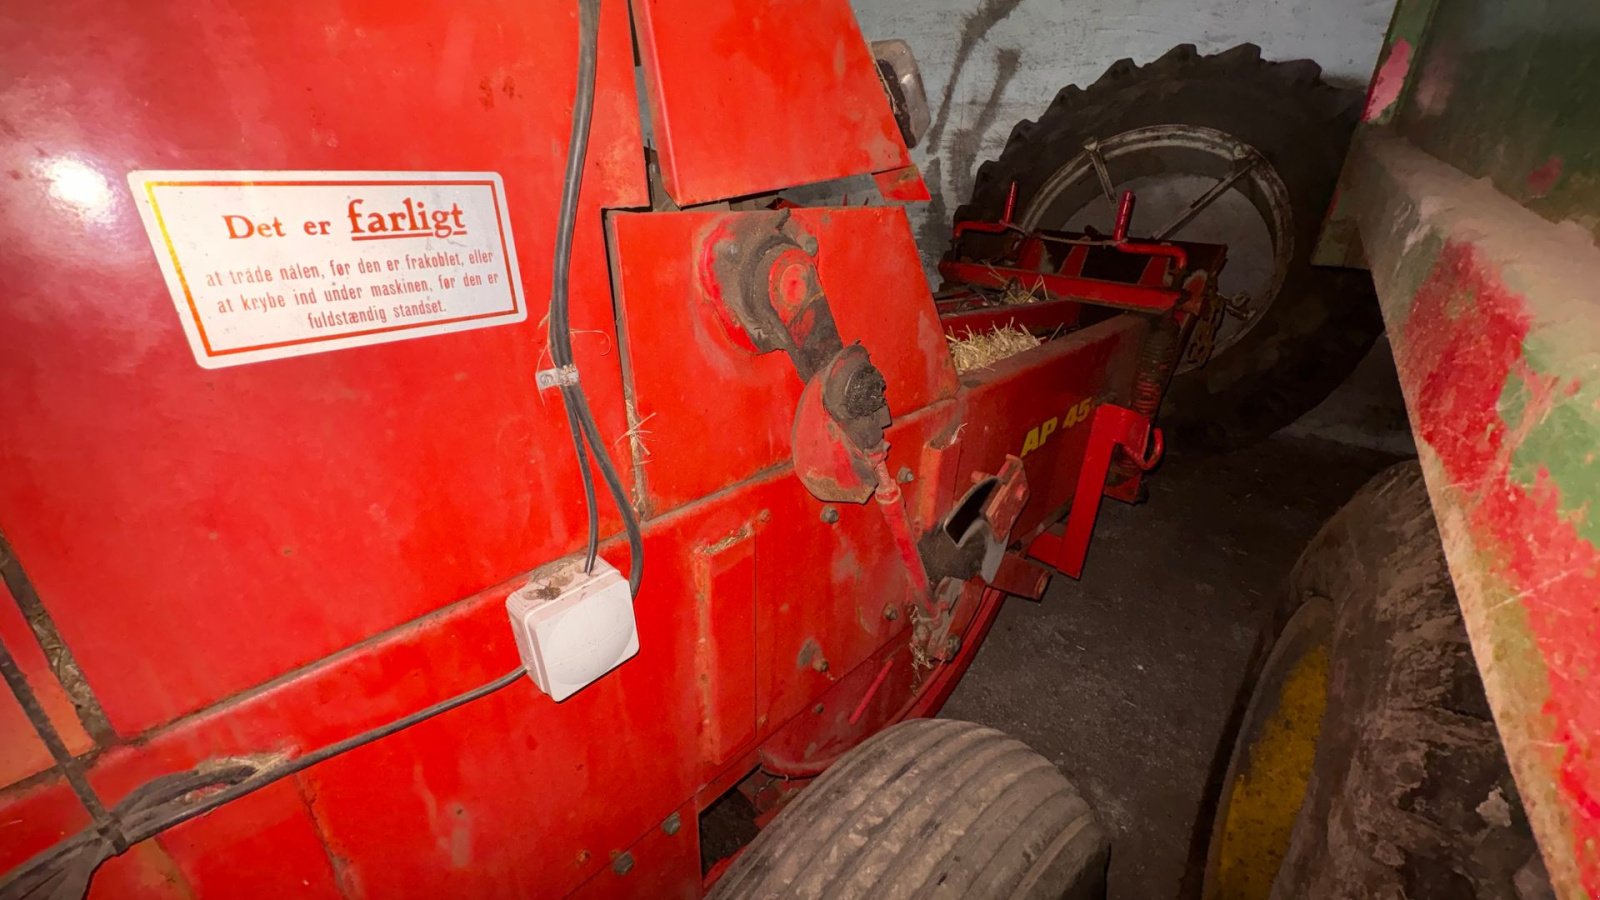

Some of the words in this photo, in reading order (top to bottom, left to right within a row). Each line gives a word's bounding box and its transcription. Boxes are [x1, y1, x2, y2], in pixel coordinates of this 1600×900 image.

[221, 214, 286, 240] Det
[303, 220, 331, 236] er
[347, 197, 466, 239] farligt
[206, 270, 223, 287] at
[229, 265, 273, 285] tråde
[279, 262, 325, 280] nålen,
[329, 259, 351, 277] før
[358, 257, 382, 274] den
[387, 259, 400, 272] er
[405, 250, 464, 270] frakoblet,
[468, 249, 494, 264] eller
[217, 298, 234, 314] at
[240, 292, 286, 313] krybe
[294, 287, 317, 306] ind
[324, 284, 363, 302] under
[370, 278, 433, 298] maskinen,
[438, 274, 456, 290] før
[463, 272, 482, 287] den
[488, 272, 499, 284] er
[307, 304, 387, 329] fuldstændig
[393, 299, 447, 319] standset.
[1020, 416, 1058, 459] AP
[1062, 397, 1092, 429] 45
